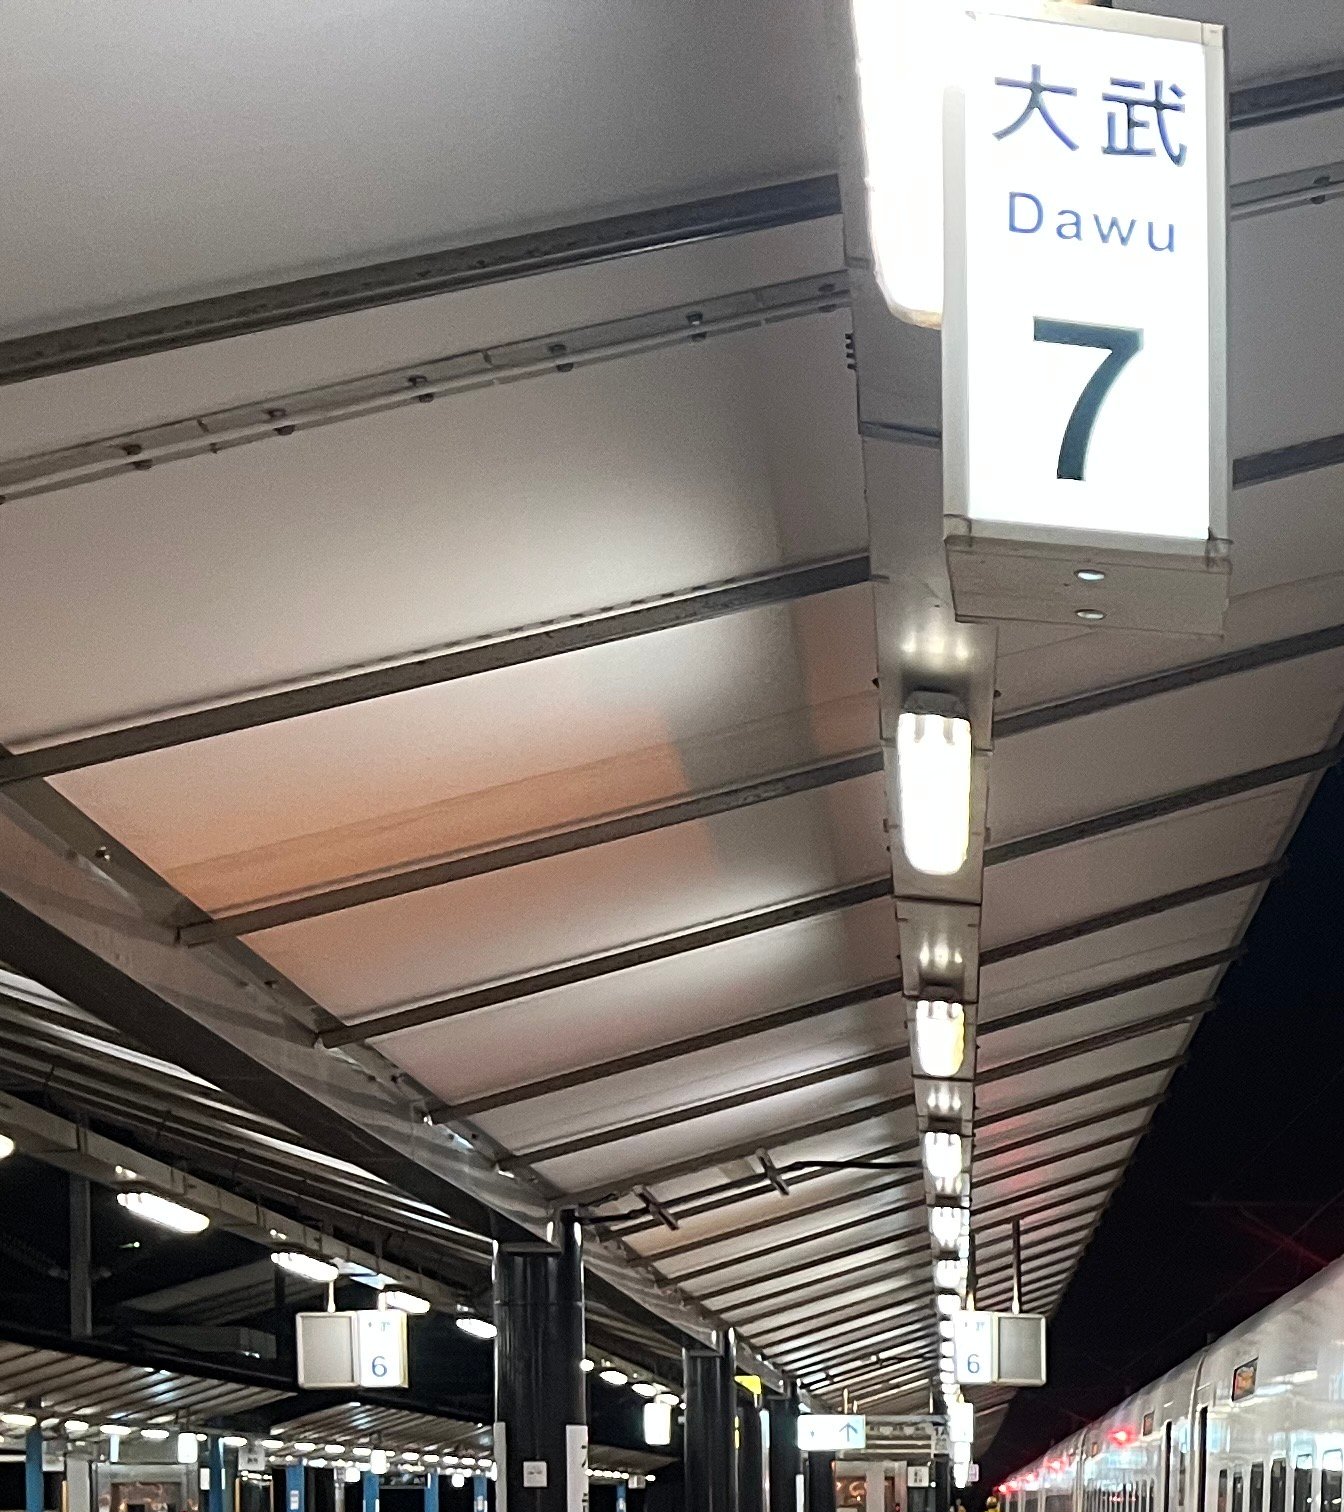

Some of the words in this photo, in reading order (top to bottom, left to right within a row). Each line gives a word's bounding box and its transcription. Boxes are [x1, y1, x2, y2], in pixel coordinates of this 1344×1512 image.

[993, 64, 1187, 167] 大武
[1008, 191, 1178, 254] Dawu
[1033, 316, 1145, 481] 7
[371, 1355, 388, 1378] 6
[967, 1353, 980, 1374] 6
